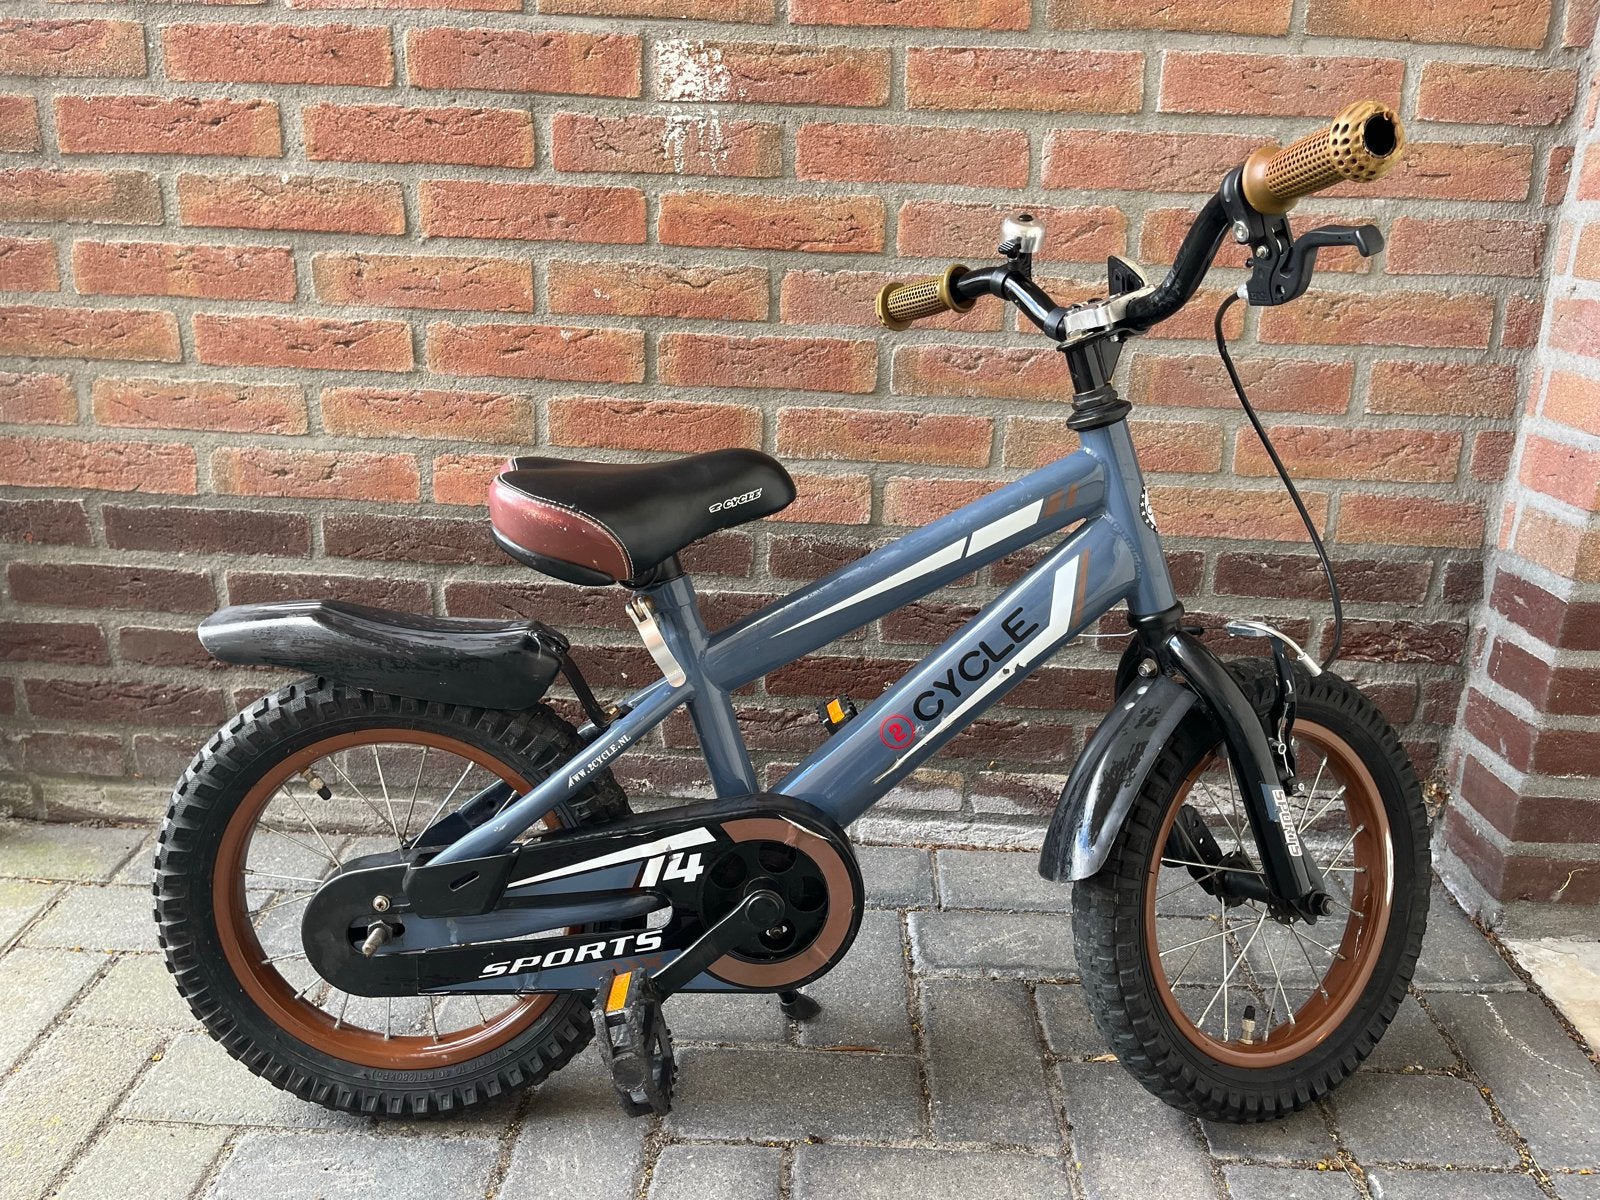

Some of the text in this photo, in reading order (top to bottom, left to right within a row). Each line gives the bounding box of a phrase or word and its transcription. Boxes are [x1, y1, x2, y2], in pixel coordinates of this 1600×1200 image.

[723, 487, 763, 510] CYCLE
[886, 606, 1040, 745] 2 CYCLE
[1271, 789, 1303, 857] SPORTS
[639, 852, 704, 888] 14
[478, 929, 663, 979] SPORTS
